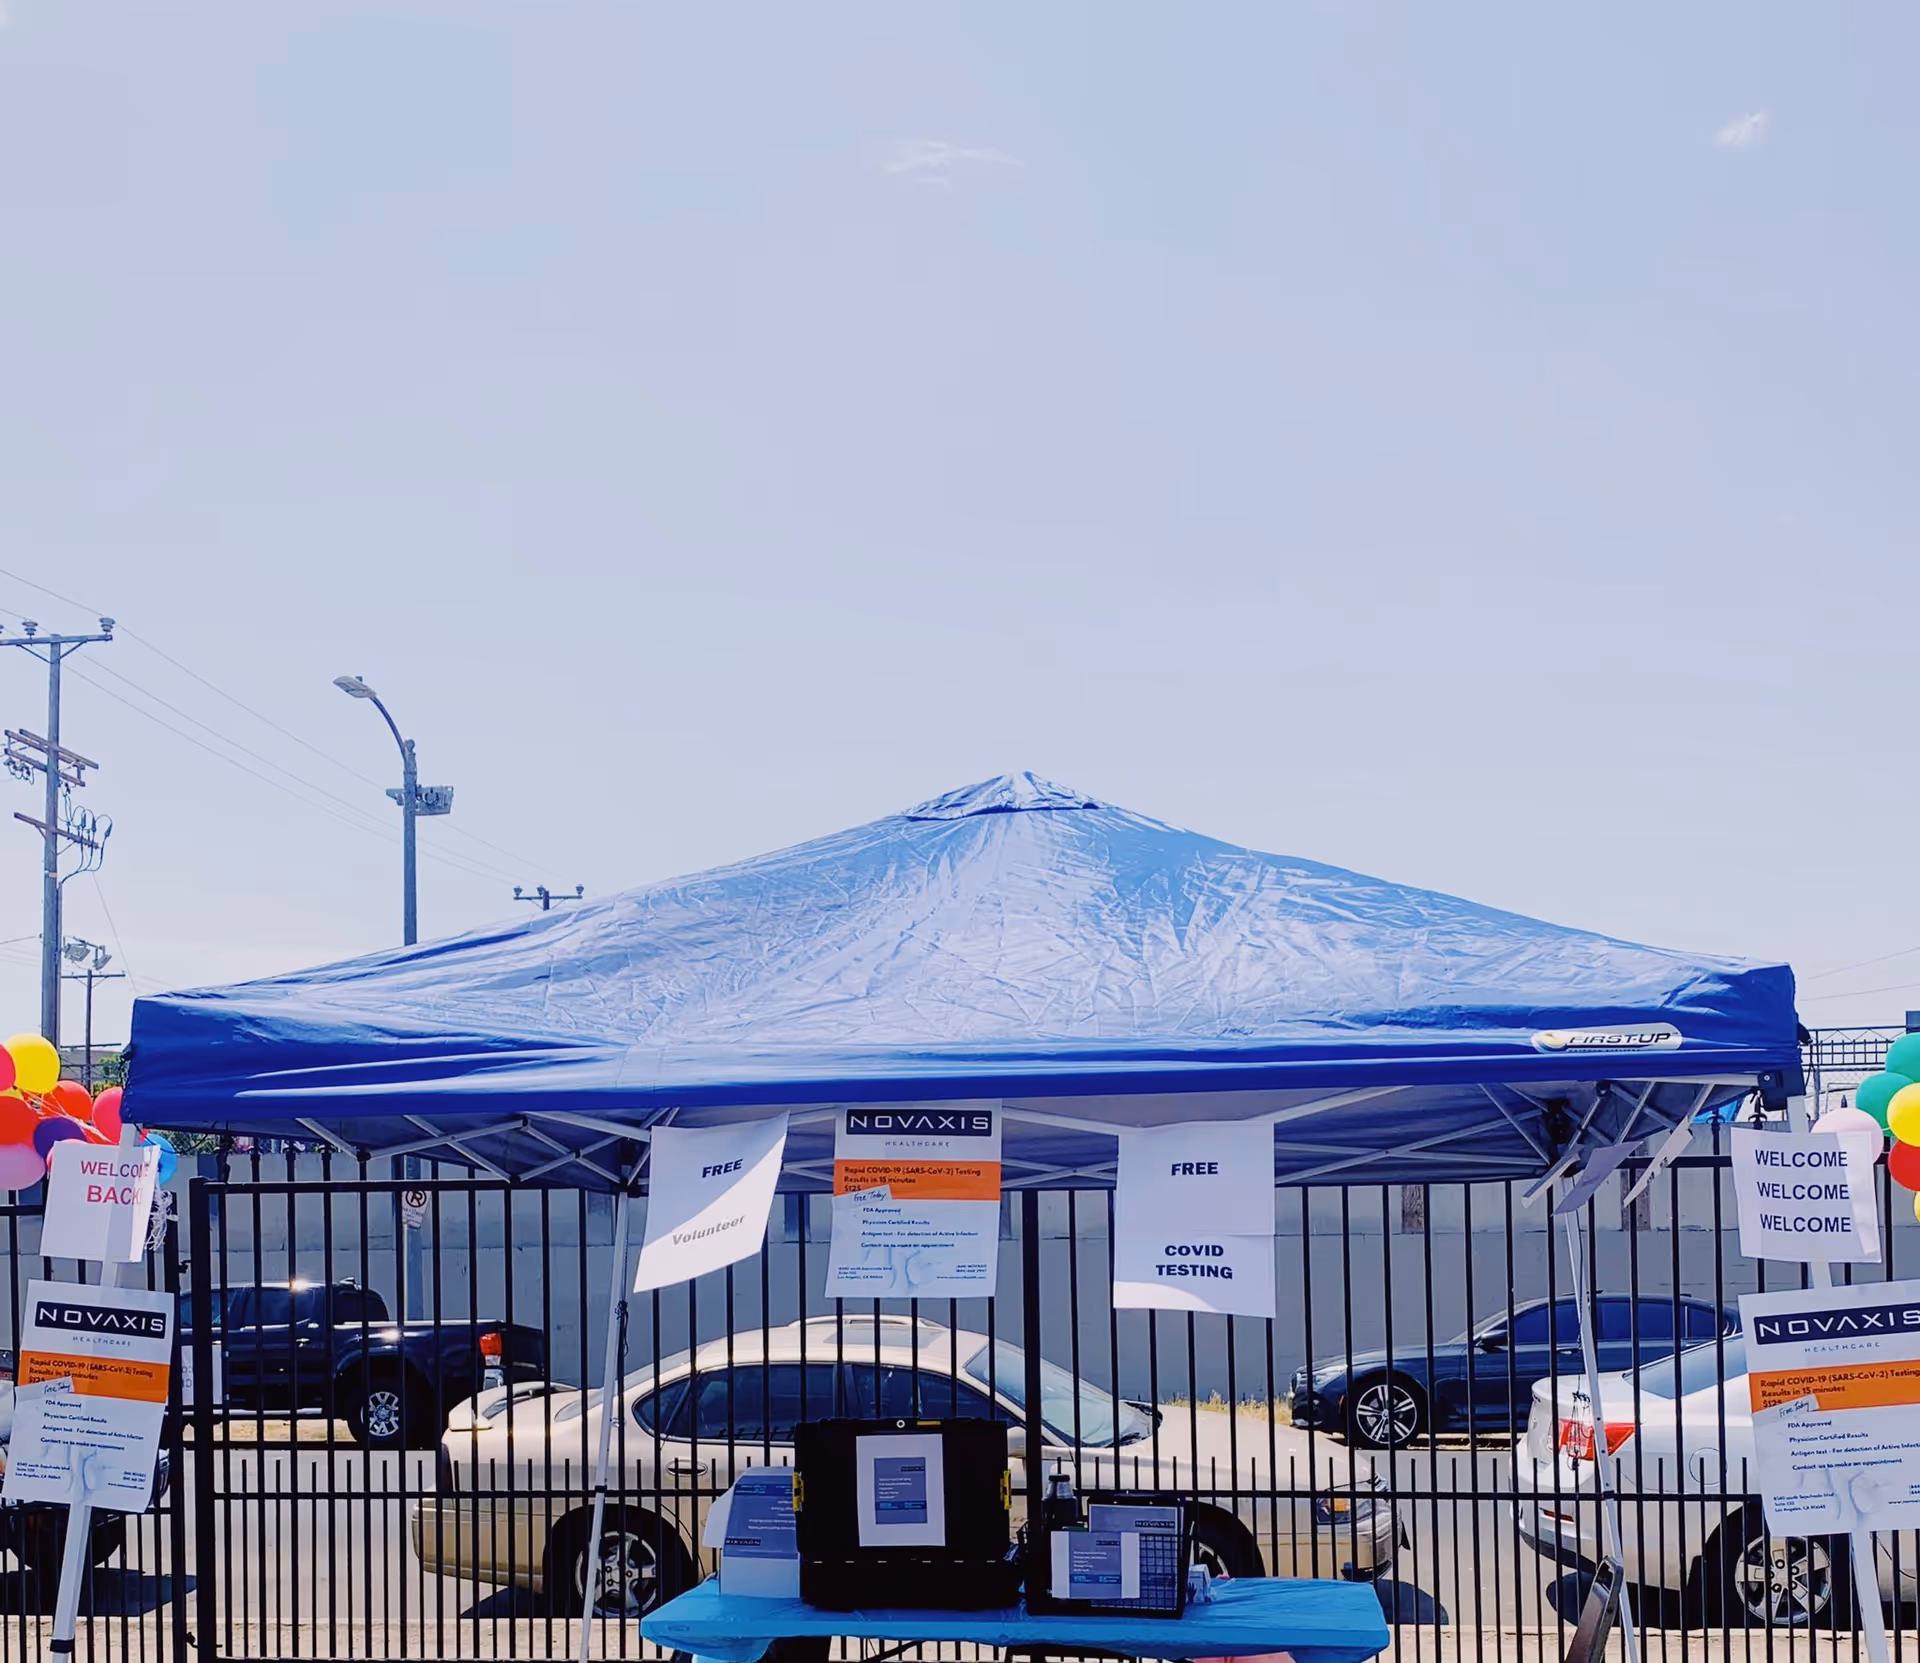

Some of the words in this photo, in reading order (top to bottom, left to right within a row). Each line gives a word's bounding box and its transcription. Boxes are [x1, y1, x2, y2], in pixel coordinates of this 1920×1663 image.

[850, 1115, 989, 1130] NOVAXIS
[1755, 1149, 1848, 1167] WELCOME
[81, 1160, 149, 1178] WELCO
[702, 1158, 743, 1178] FREE
[844, 1166, 865, 1174] Rapid
[902, 1167, 954, 1175] (SARS-CoV-2)
[955, 1168, 981, 1176] Testing
[1171, 1162, 1219, 1176] FREE
[1757, 1181, 1849, 1200] WELCOME
[1760, 1213, 1852, 1232] WELCOME
[672, 1215, 746, 1246] Volunteer
[1164, 1245, 1224, 1257] COVID
[1156, 1264, 1233, 1279] TESTING
[39, 1308, 164, 1332] NOVAXIS
[1759, 1310, 1920, 1338] NOVAXIS
[73, 1336, 131, 1346] HEALTHCARE
[1804, 1342, 1880, 1353] HEALTHCARE
[30, 1357, 51, 1366] Rapid
[52, 1360, 86, 1369] COVID-19
[1760, 1379, 1785, 1388] Rapid
[1787, 1375, 1827, 1385] COVID-19
[1828, 1370, 1889, 1384] (SARS-CoV-2)
[1890, 1368, 1920, 1377] Testing
[1761, 1388, 1791, 1397] Results
[1792, 1387, 1800, 1396] in
[1812, 1385, 1846, 1394] minutes
[1801, 1420, 1832, 1428] Approved
[1862, 1458, 1903, 1466] appointment
